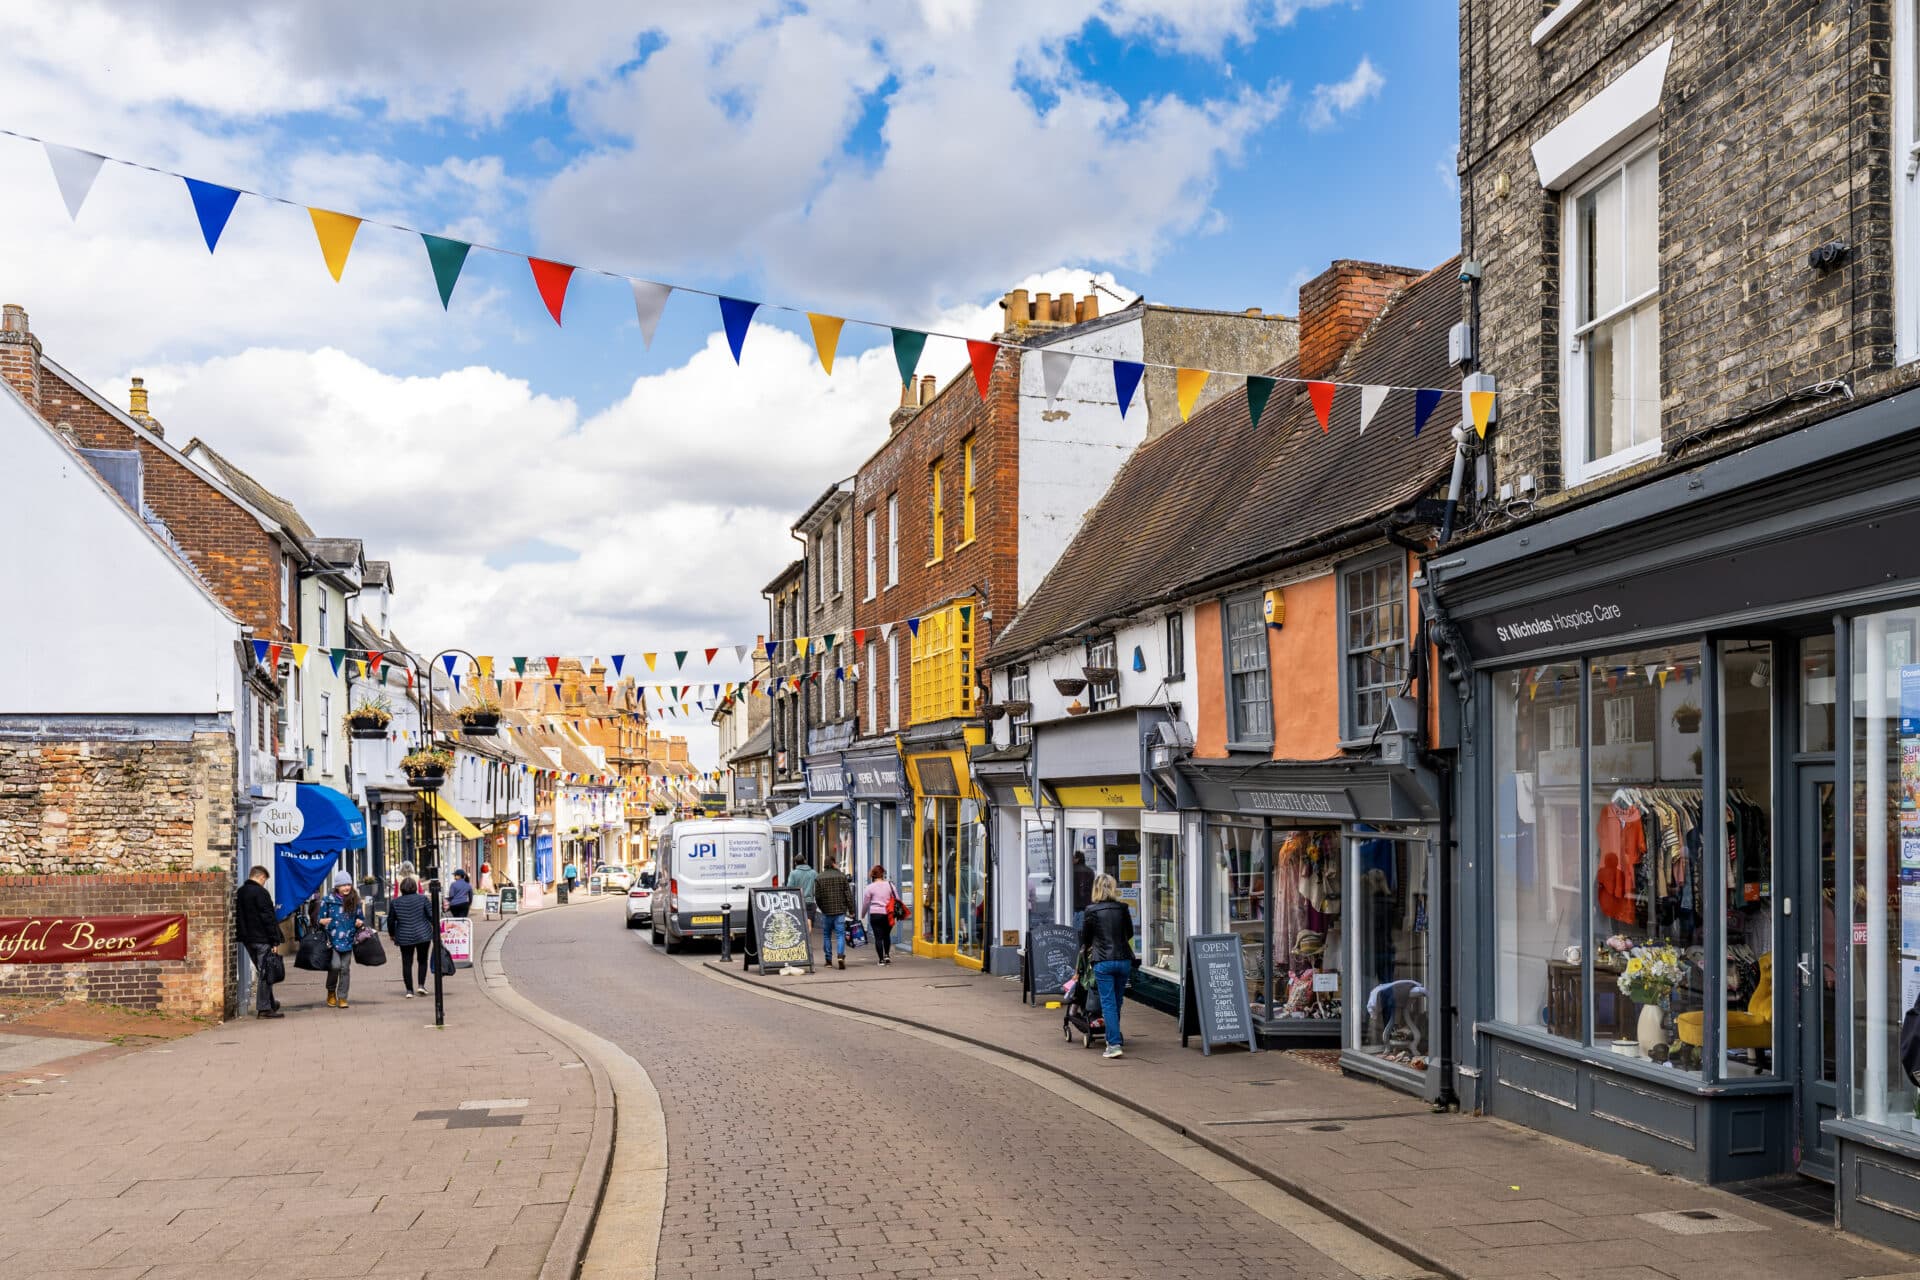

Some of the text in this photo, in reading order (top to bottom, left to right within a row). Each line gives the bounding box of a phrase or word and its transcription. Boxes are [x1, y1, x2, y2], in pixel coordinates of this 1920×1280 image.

[1496, 604, 1621, 642] St Nicholas Hospice Care
[1249, 791, 1332, 812] ELIZABETH GASH
[260, 821, 299, 836] Nails
[688, 842, 716, 858] JPI
[62, 921, 137, 951] Beers
[1854, 930, 1868, 942] OPE
[1202, 942, 1229, 953] OPEN
